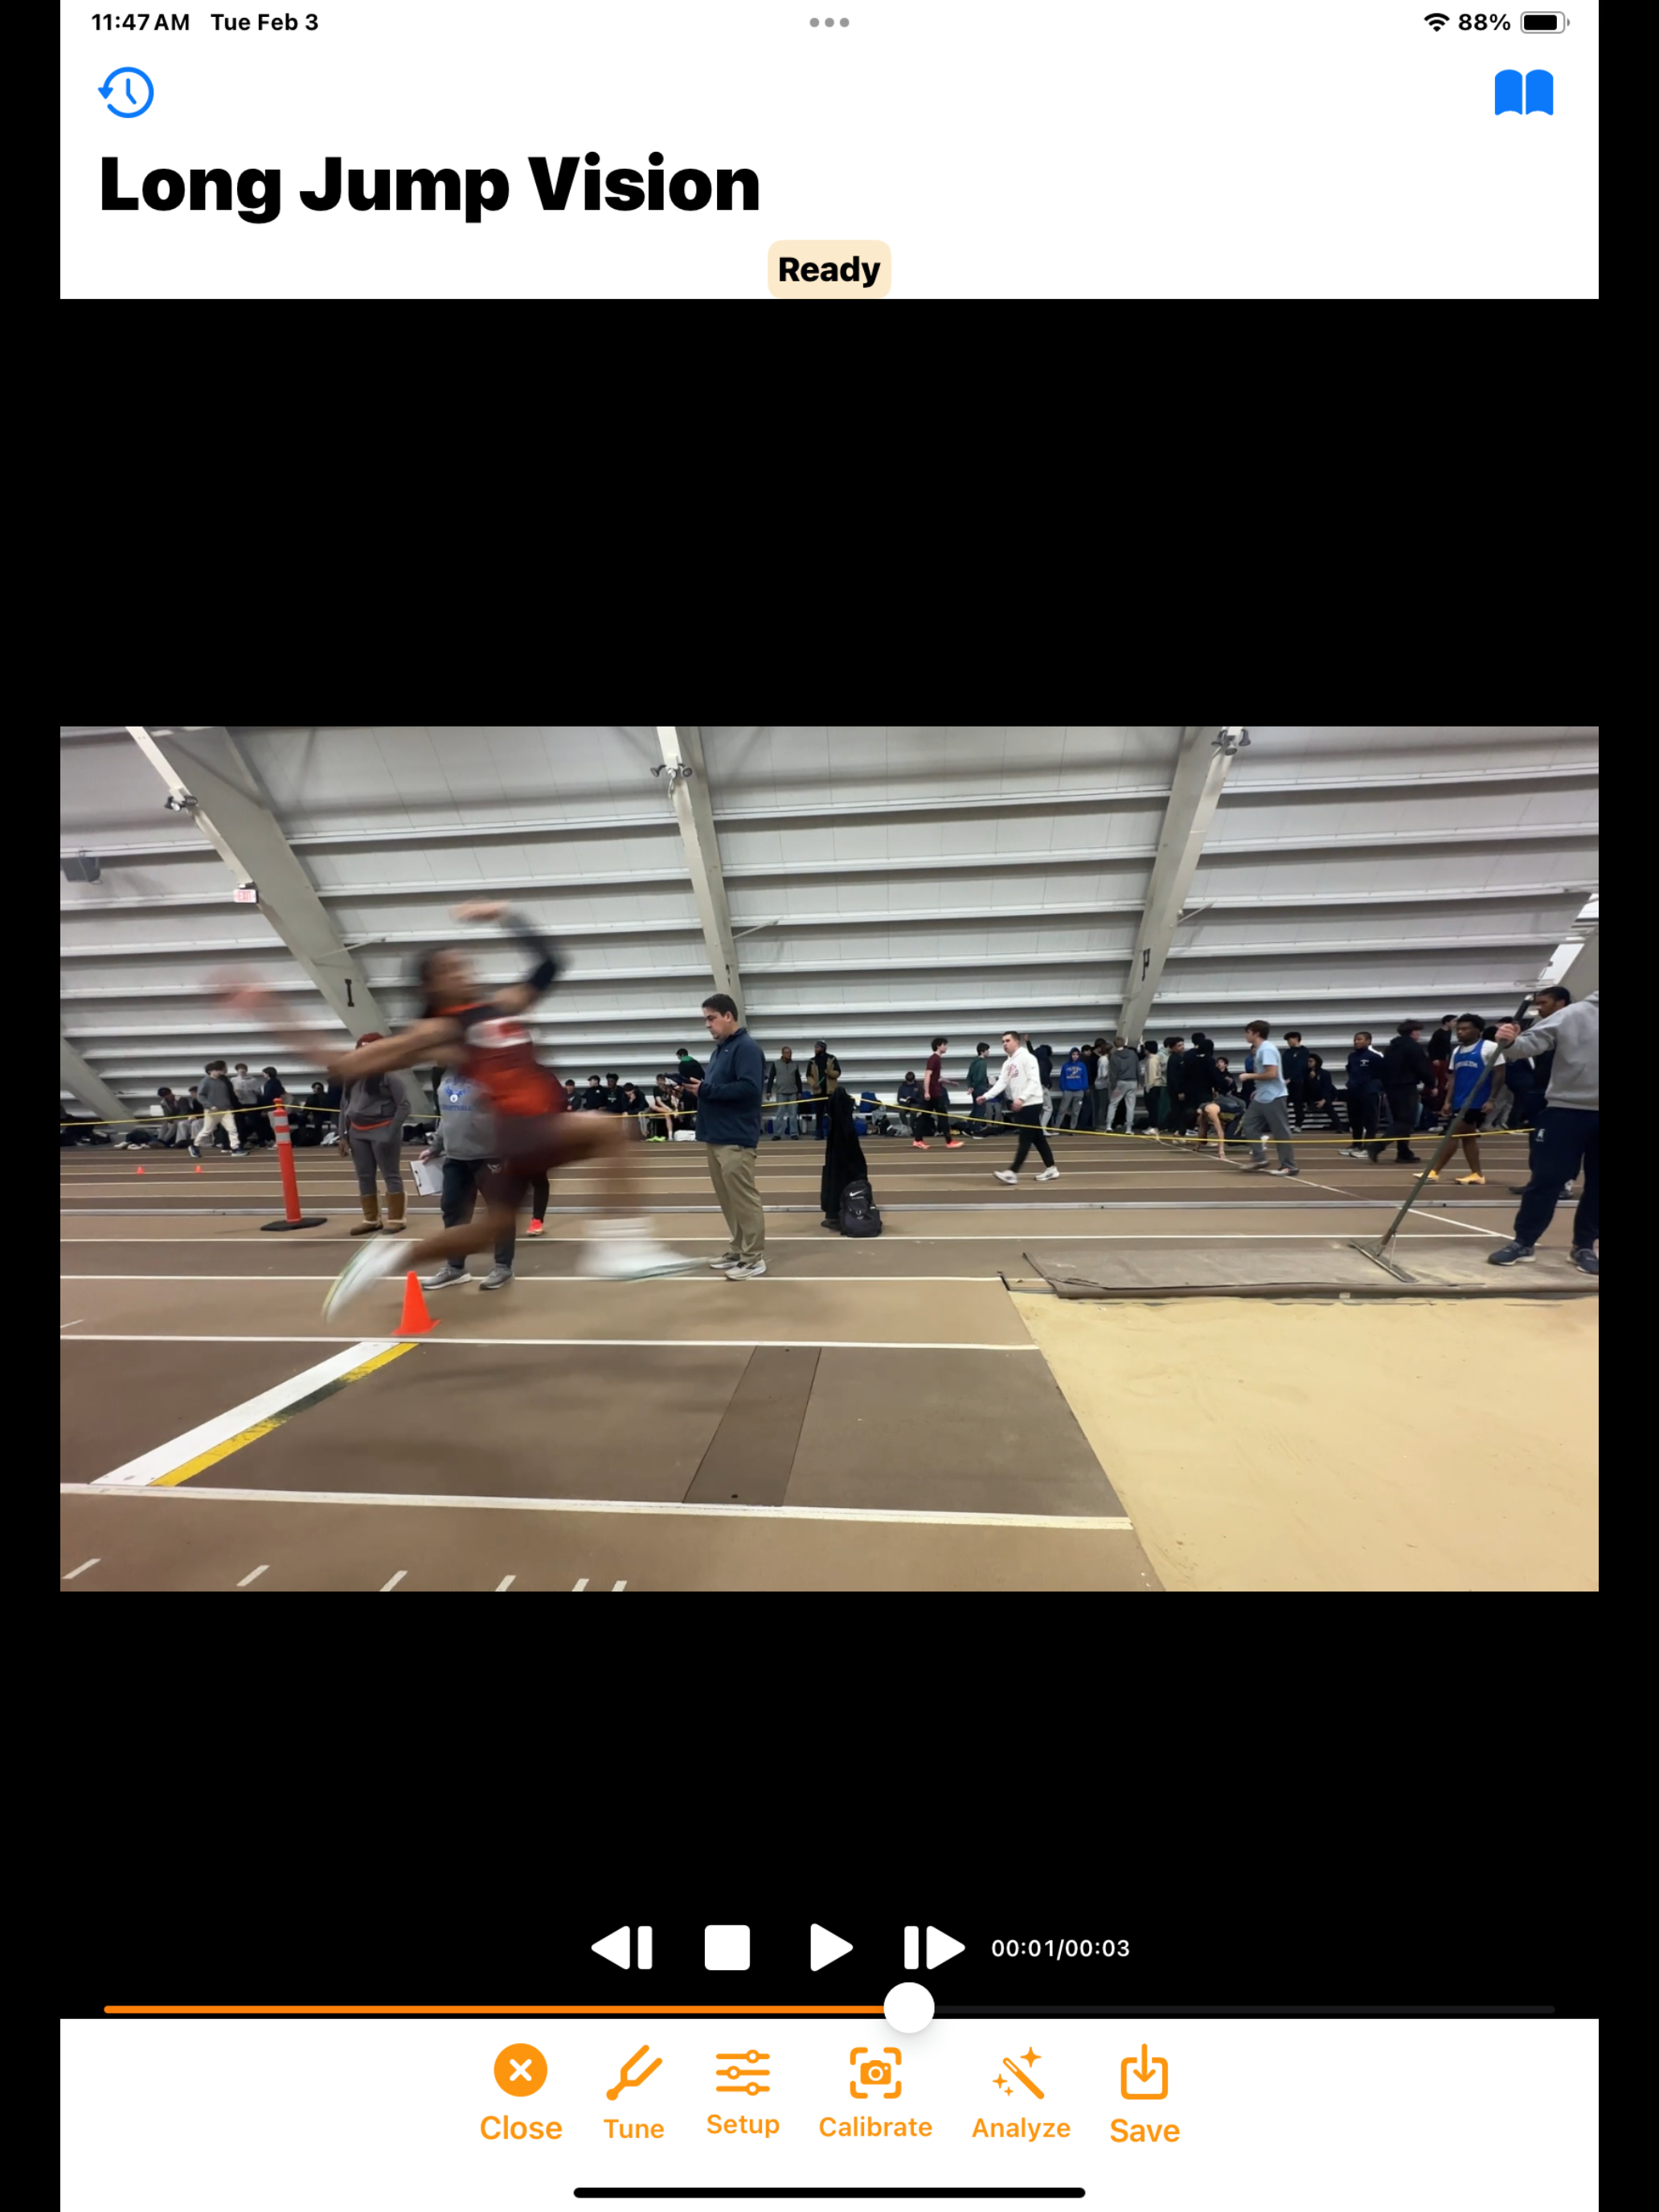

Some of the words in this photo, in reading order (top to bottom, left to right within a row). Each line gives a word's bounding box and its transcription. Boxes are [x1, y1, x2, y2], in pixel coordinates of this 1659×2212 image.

[211, 13, 251, 31] Tue
[259, 12, 299, 31] Feb
[305, 13, 319, 31] 3
[1458, 13, 1511, 31] 88%
[101, 156, 281, 225] Long
[300, 156, 510, 224] Jump
[527, 151, 760, 212] Vision
[779, 255, 882, 289] Ready
[991, 1939, 1130, 1961] 00:01/00:03
[480, 2114, 563, 2140] Close
[603, 2118, 665, 2139] Tune
[707, 2113, 780, 2139] Setup
[818, 2115, 933, 2138] Calibrate
[971, 2116, 1071, 2143] Analyze
[1110, 2117, 1181, 2144] Save
